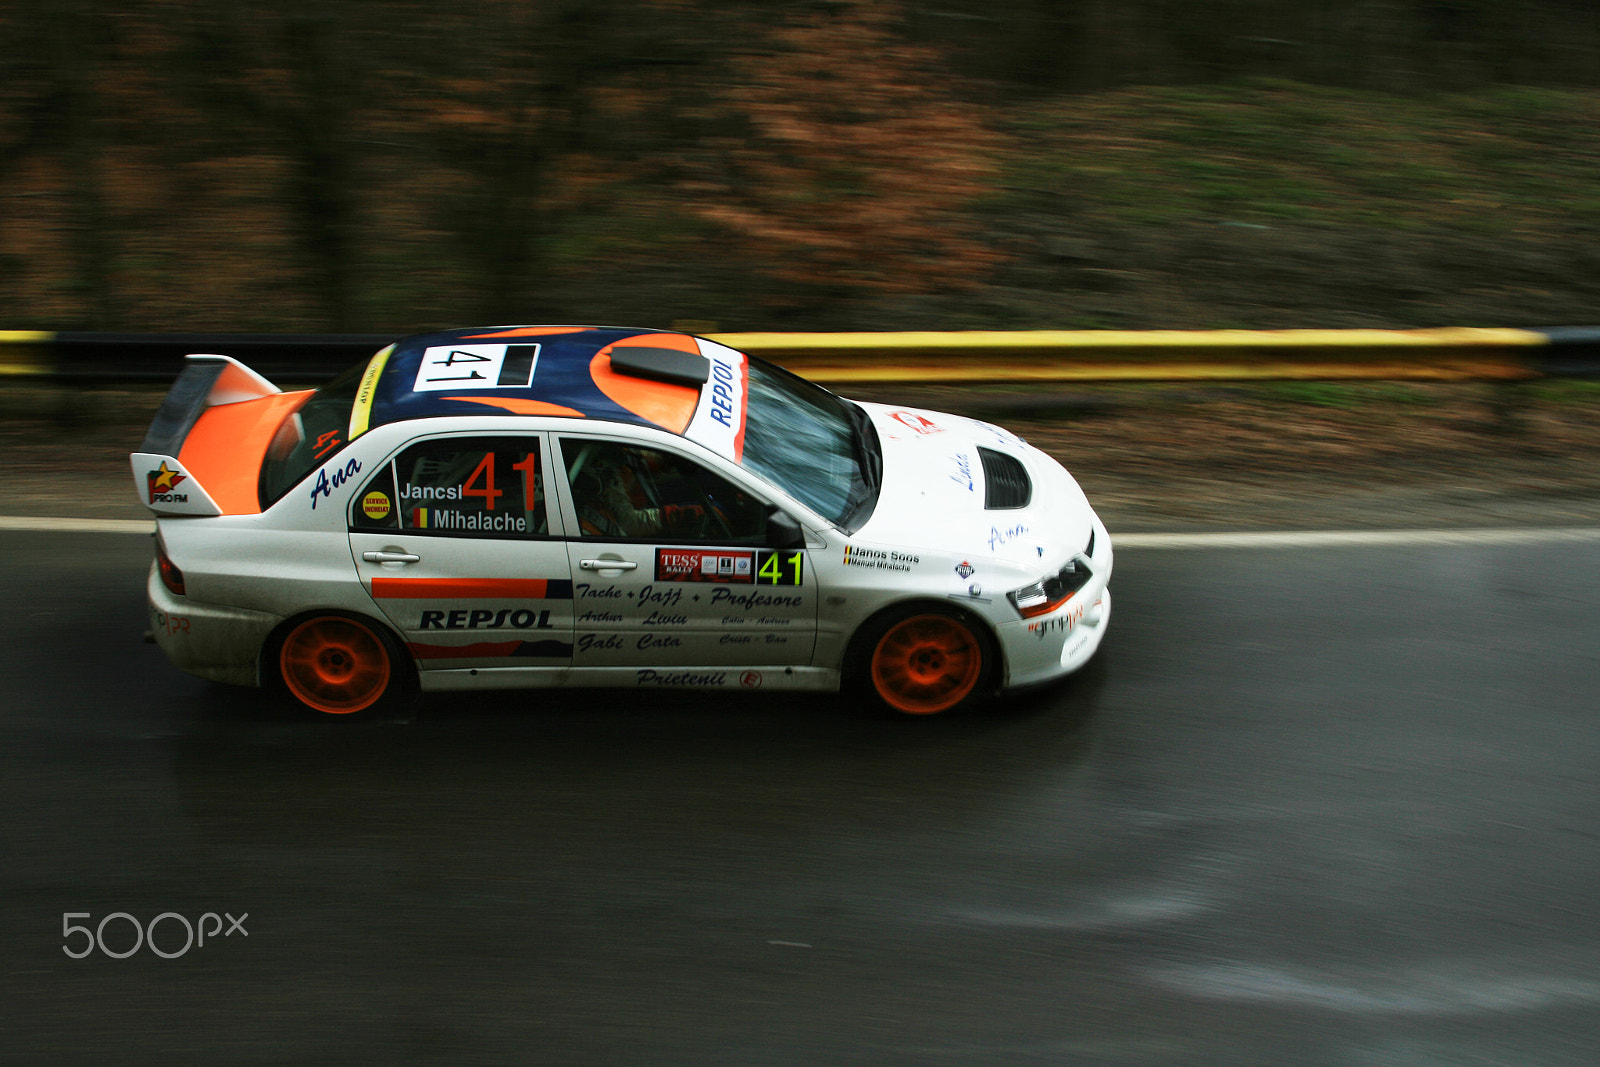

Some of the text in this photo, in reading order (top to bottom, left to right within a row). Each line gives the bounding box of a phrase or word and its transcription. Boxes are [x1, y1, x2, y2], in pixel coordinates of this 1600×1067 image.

[426, 351, 492, 382] 41
[710, 358, 733, 428] REPSOL
[312, 429, 342, 460] 41
[310, 457, 363, 510] Ana
[400, 482, 463, 500] Jancsi
[461, 452, 535, 511] 41
[154, 493, 189, 503] PRO FM
[365, 497, 388, 505] SERVICE
[434, 509, 527, 532] Mihalache
[661, 554, 699, 567] TESS
[853, 546, 921, 564] Janos Soos
[666, 566, 695, 575] RALLY
[758, 551, 802, 586] 41
[876, 560, 911, 573] Mihalache
[576, 583, 623, 600] Tache
[711, 587, 803, 610] Profesore
[419, 609, 553, 629] REPSOL
[578, 610, 688, 625] Arthur Liviu
[577, 633, 682, 652] Gabi Cata
[636, 669, 726, 687] Prietenii
